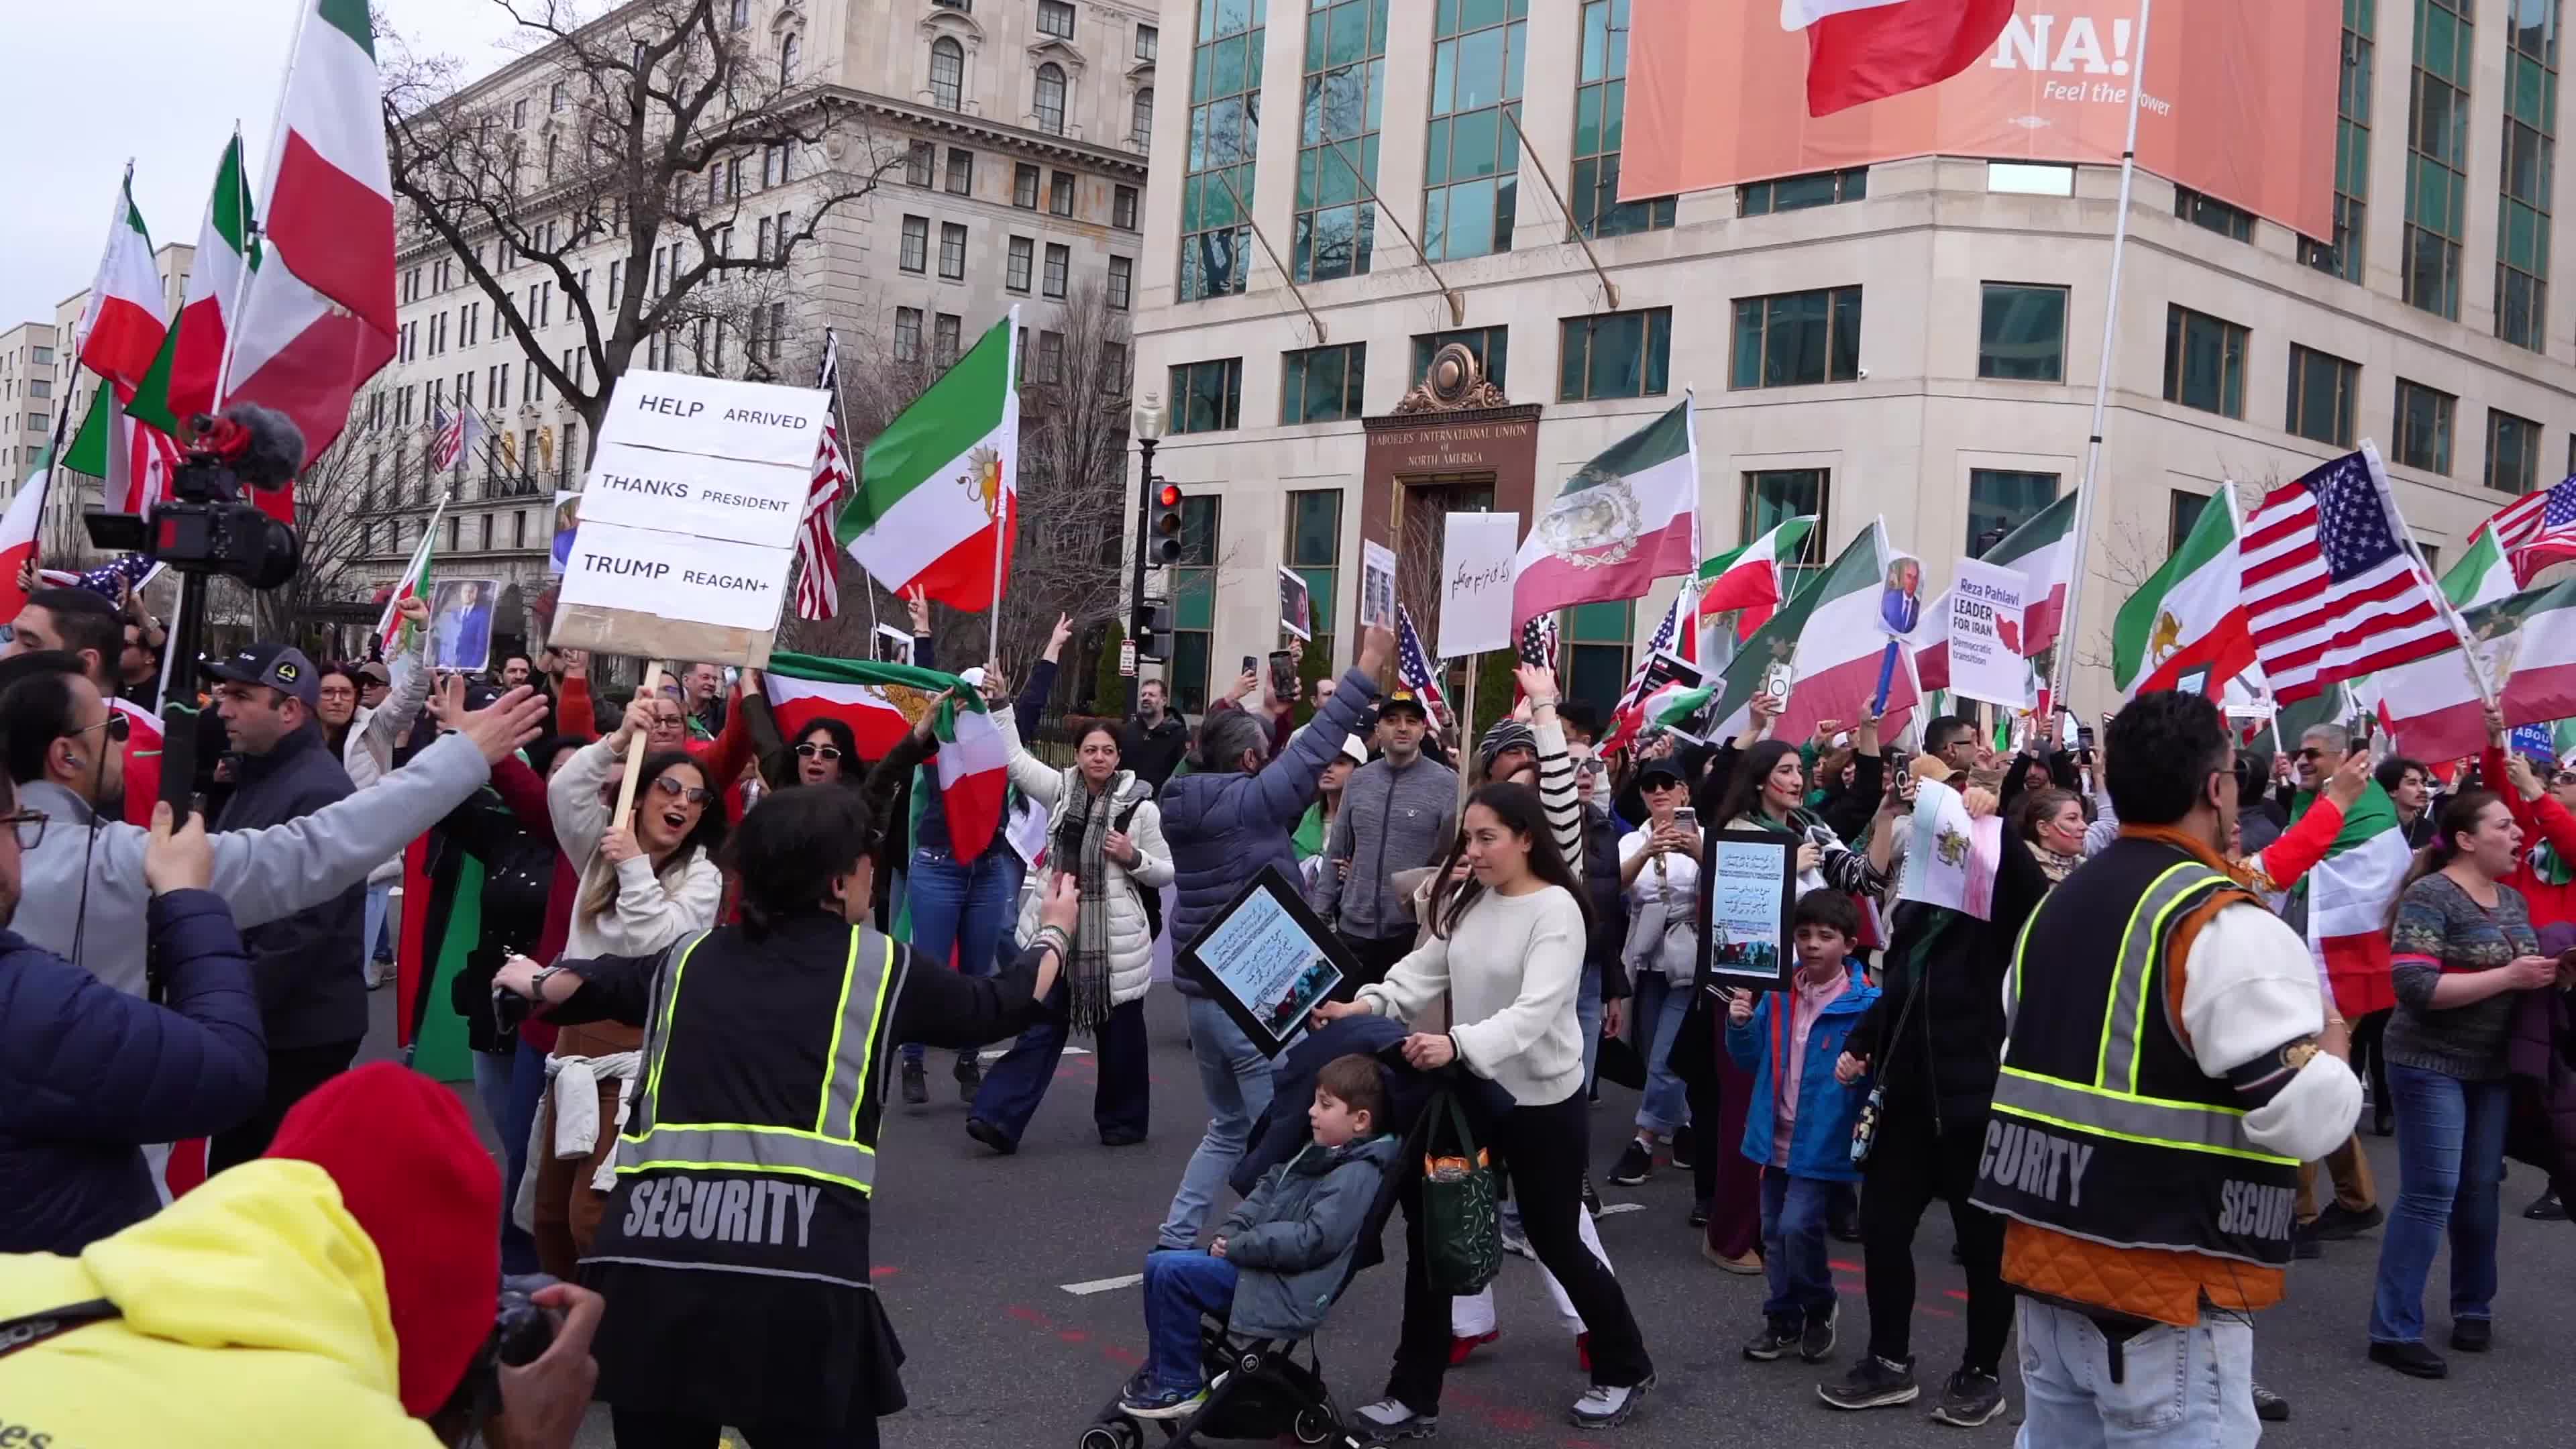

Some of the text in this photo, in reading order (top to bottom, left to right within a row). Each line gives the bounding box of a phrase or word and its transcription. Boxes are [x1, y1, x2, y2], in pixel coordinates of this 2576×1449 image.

[1990, 13, 2131, 75] NA!
[2043, 80, 2086, 101] Feel
[2092, 82, 2126, 103] the
[639, 394, 808, 430] HELP ARRIVED
[1419, 427, 1489, 443] INTERNATIONAL
[1495, 423, 1527, 437] UNION
[1407, 452, 1483, 466] NORTH AMERICA
[602, 474, 790, 513] THANKS PRESIDENT
[584, 554, 769, 592] TRUMP REAGAN+
[1960, 578, 2021, 606] Reza Pahlavi
[1954, 598, 1992, 621] LEADER
[1953, 616, 1992, 637] FOR IRAN
[1953, 637, 1992, 655] Democratic
[1953, 651, 1986, 665] transition
[2515, 727, 2550, 743] ABOU
[1980, 1119, 2094, 1208] CURITY
[623, 1175, 821, 1248] SECURITY
[0, 1426, 53, 1449] es
